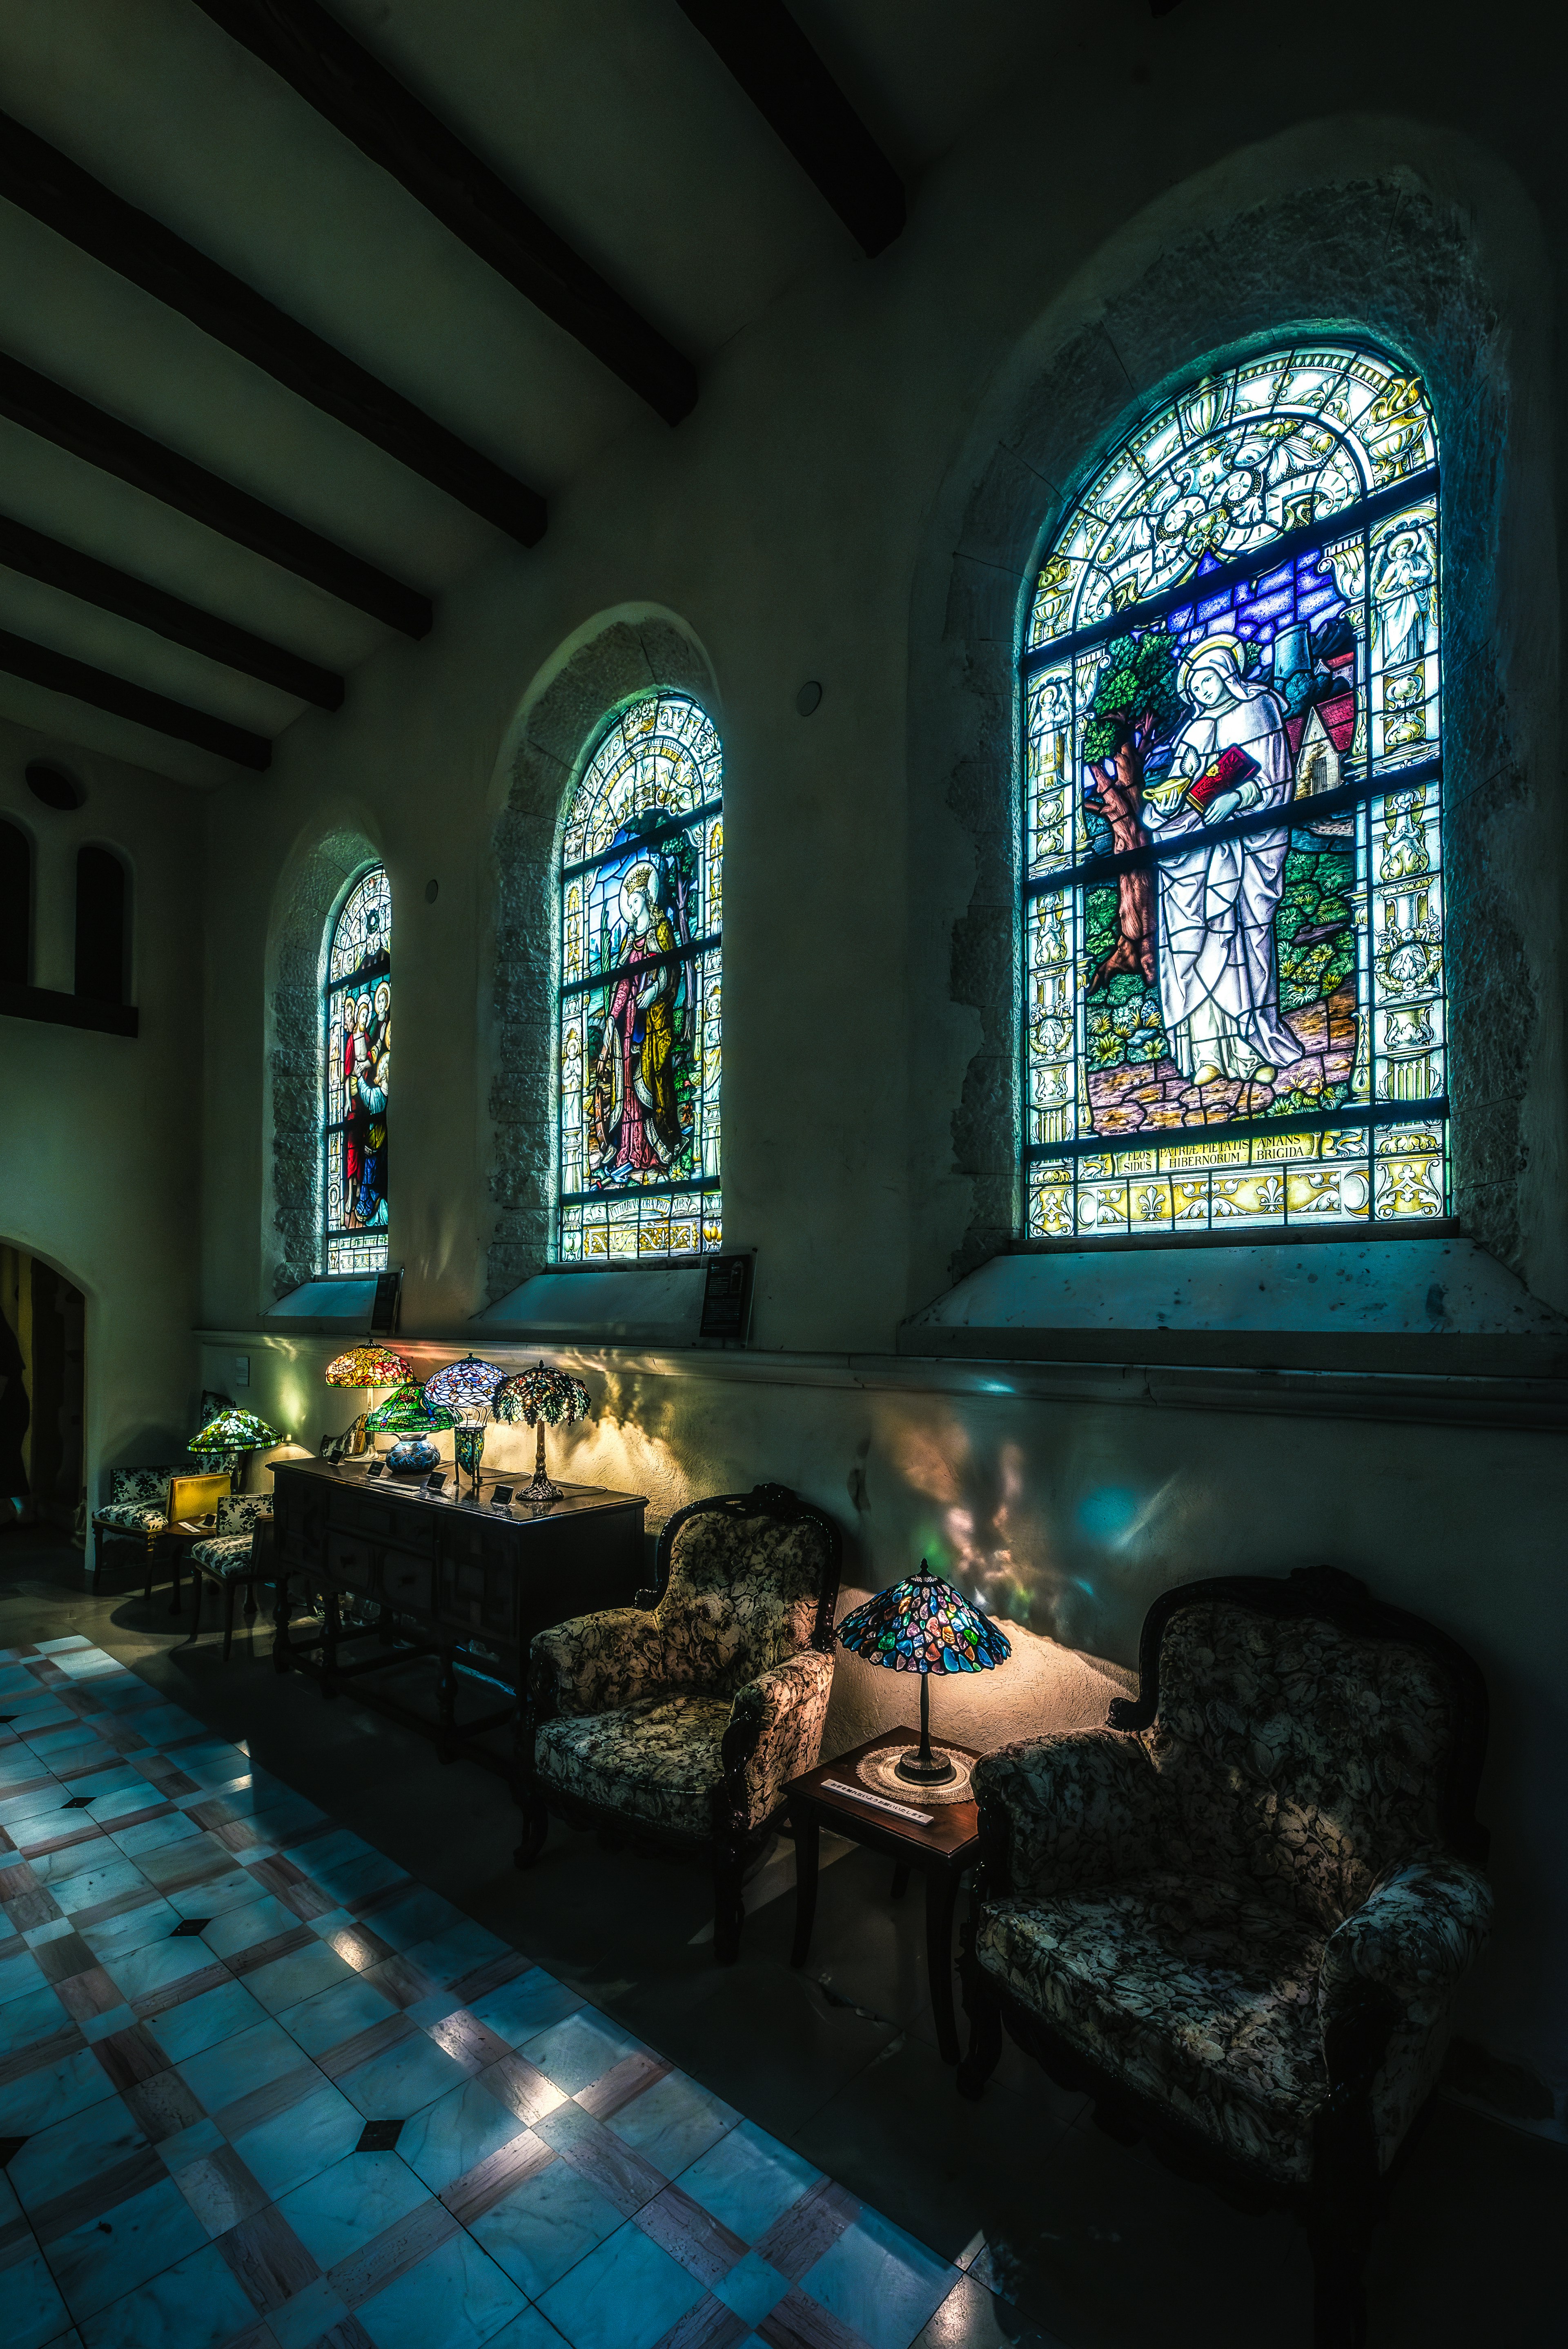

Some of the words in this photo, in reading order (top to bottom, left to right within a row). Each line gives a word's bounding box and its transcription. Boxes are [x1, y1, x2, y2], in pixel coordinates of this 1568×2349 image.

[1124, 1161, 1151, 1172] SIDUS
[1169, 1152, 1240, 1168] HIBERNORUM
[1257, 1146, 1304, 1160] BRIGIDA
[1128, 1150, 1151, 1161] FLOS
[1203, 1140, 1249, 1153] PIETATIS
[1258, 1135, 1300, 1148] AMANS
[643, 1199, 654, 1208] ORA
[656, 1199, 667, 1211] PRO
[831, 1783, 924, 1818] お手を触れないようお願いいたします
